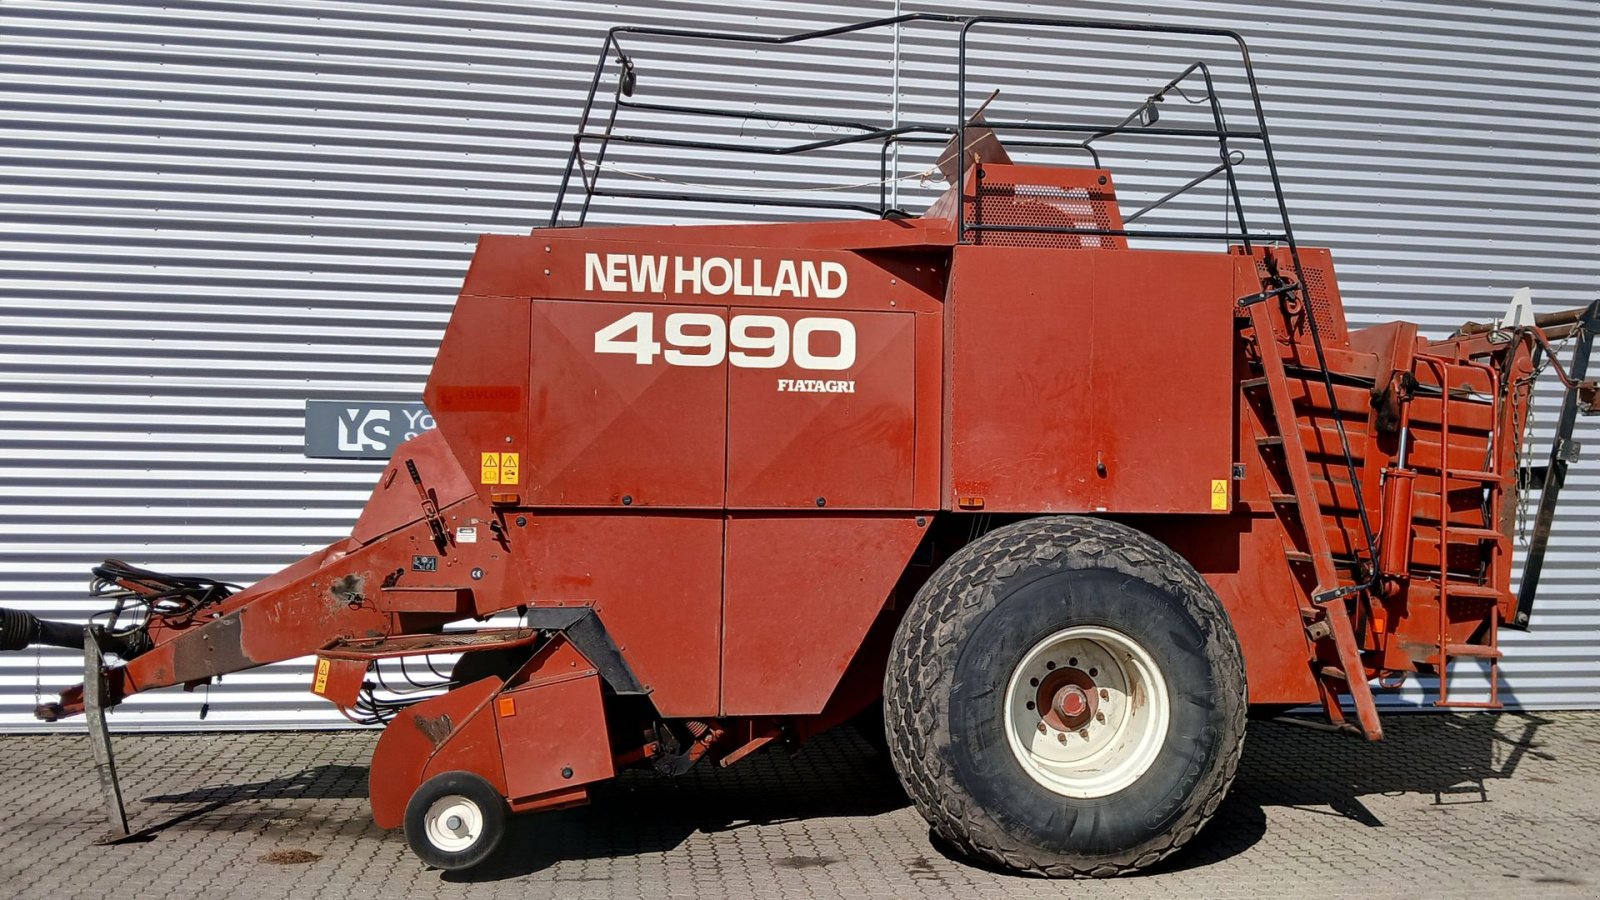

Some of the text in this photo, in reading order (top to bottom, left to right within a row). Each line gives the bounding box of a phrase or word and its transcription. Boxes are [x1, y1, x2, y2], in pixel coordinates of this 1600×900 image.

[585, 253, 848, 298] NEW HOLLAND
[594, 312, 857, 370] 4990
[777, 379, 856, 393] FIATAGRI
